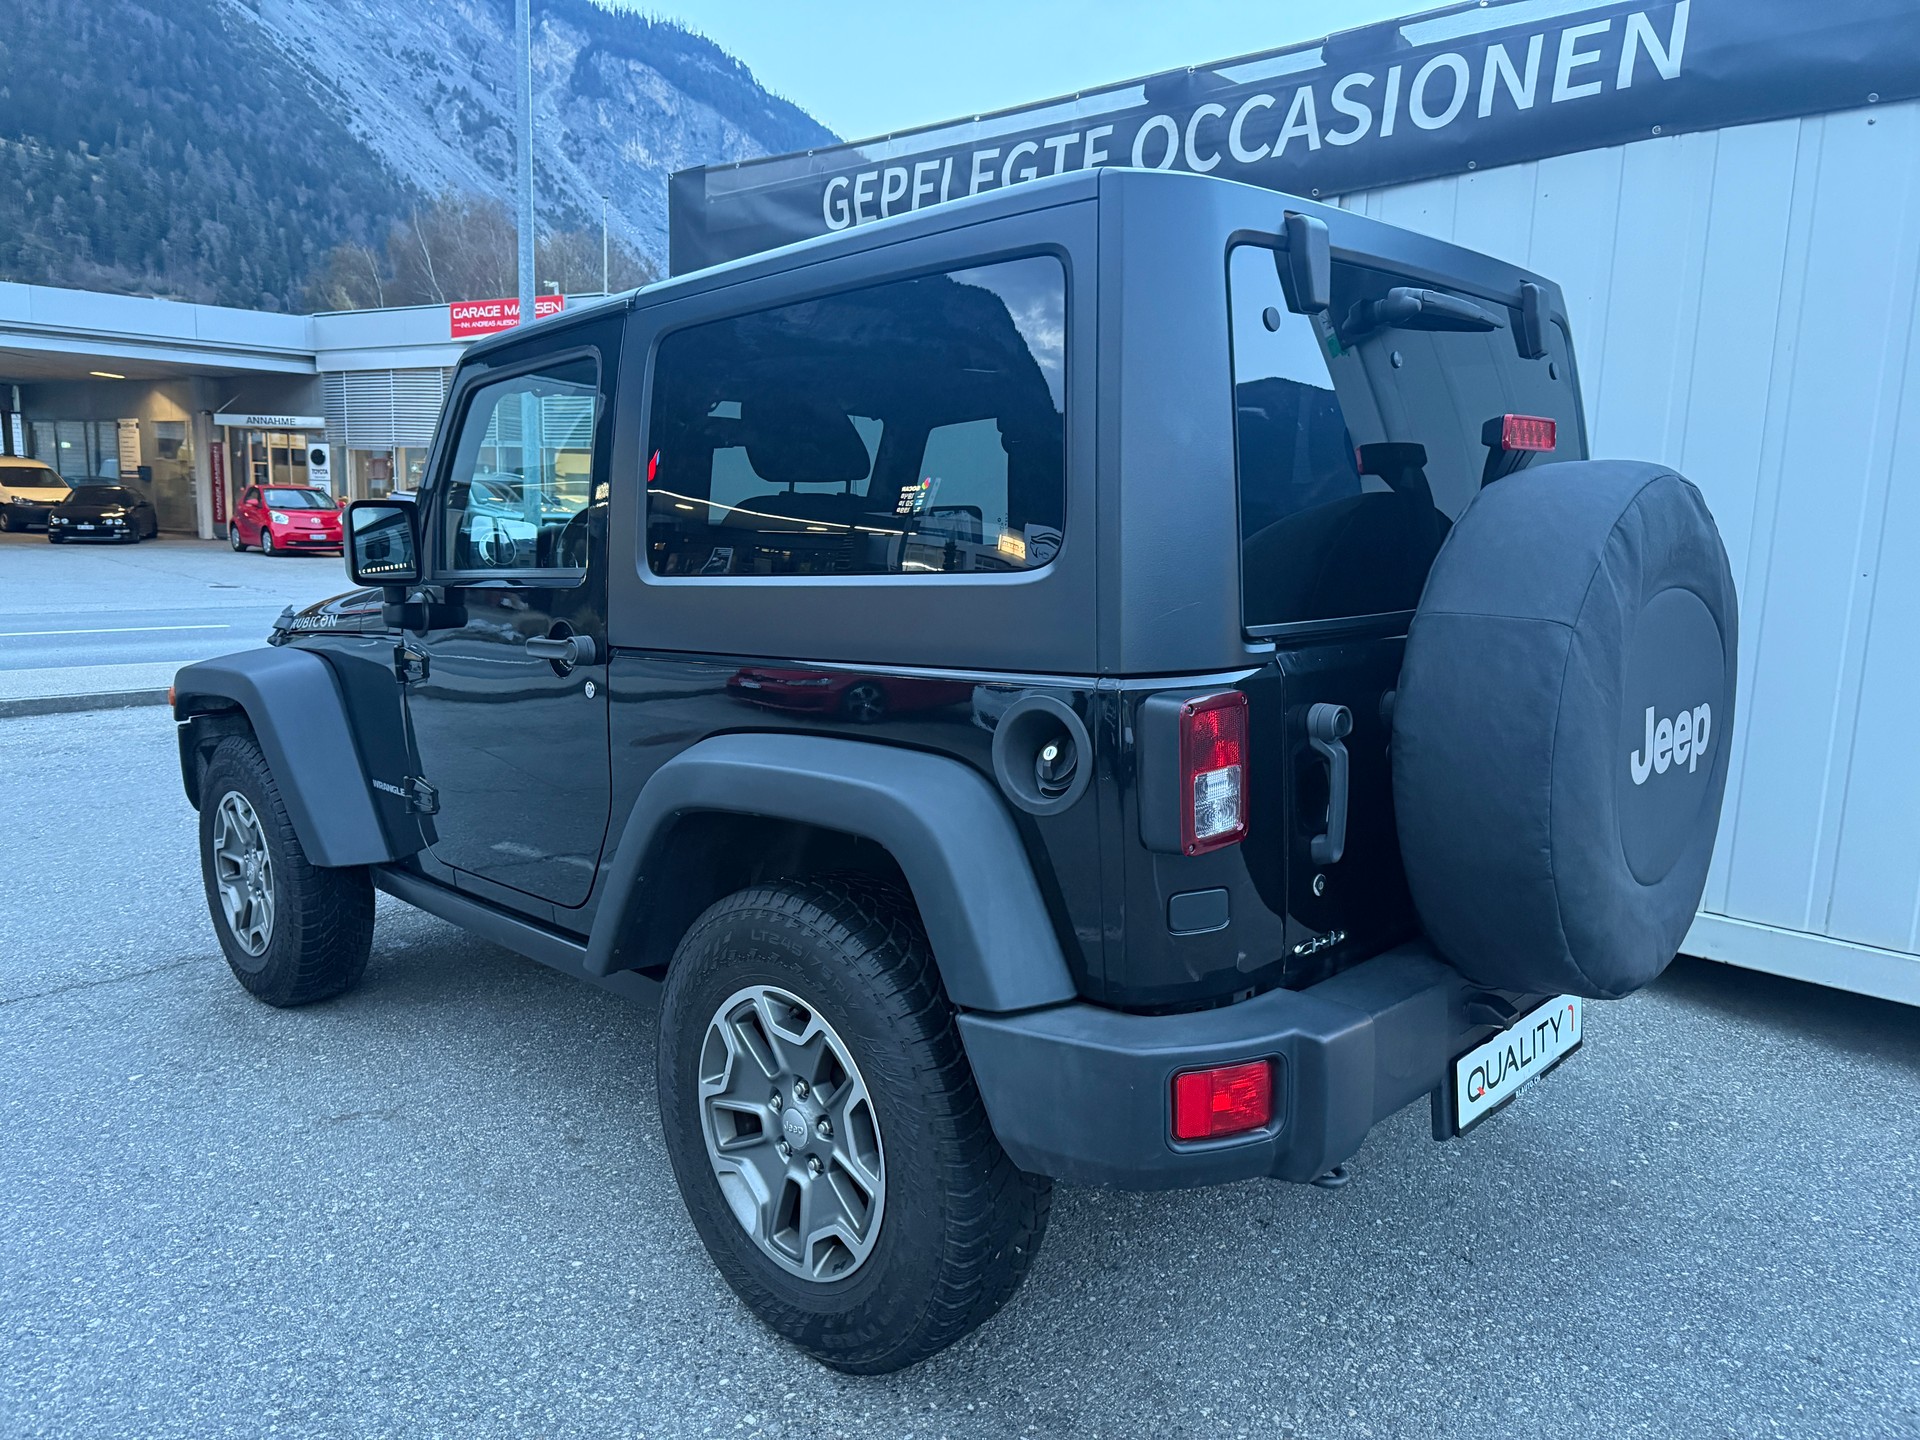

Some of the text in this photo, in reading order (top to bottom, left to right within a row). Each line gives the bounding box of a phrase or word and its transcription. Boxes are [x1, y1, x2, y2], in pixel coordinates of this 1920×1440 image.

[1131, 0, 1691, 173] OCCASIONEN
[453, 301, 562, 319] GARAGE MASEN
[246, 416, 297, 426] ANNAHME
[290, 614, 339, 630] RUBICON
[1630, 702, 1712, 786] Jeep
[372, 778, 406, 797] WRANGLE
[1467, 1004, 1574, 1103] QUALITY 1
[783, 1120, 804, 1135] Jeep
